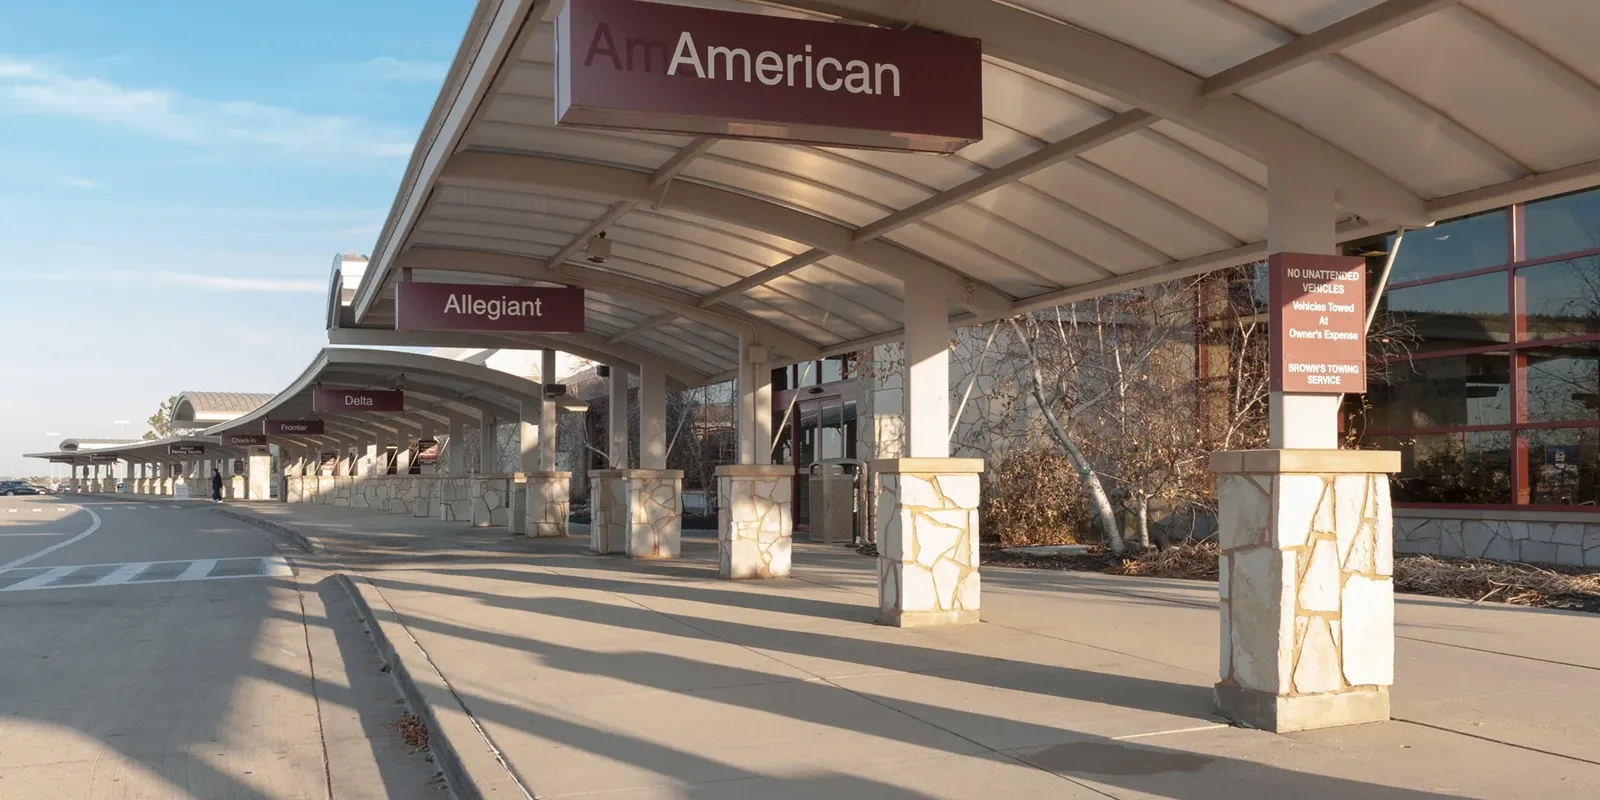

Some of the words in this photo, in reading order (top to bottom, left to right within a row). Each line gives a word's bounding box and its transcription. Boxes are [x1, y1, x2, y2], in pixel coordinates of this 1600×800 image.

[666, 31, 900, 96] American
[1287, 268, 1300, 278] NO
[1302, 269, 1359, 281] UNATTENDED
[1302, 283, 1344, 294] VEHICLES
[444, 294, 542, 320] Allegiant
[1292, 301, 1326, 312] Vehicles
[1328, 302, 1354, 313] Towed
[1319, 316, 1328, 325] At
[1289, 328, 1322, 339] Owner's
[1324, 330, 1358, 341] Expense
[1288, 363, 1326, 373] BROWN'S
[1327, 364, 1359, 374] TOWING
[1307, 375, 1341, 385] SERVICE
[344, 395, 373, 406] Delta
